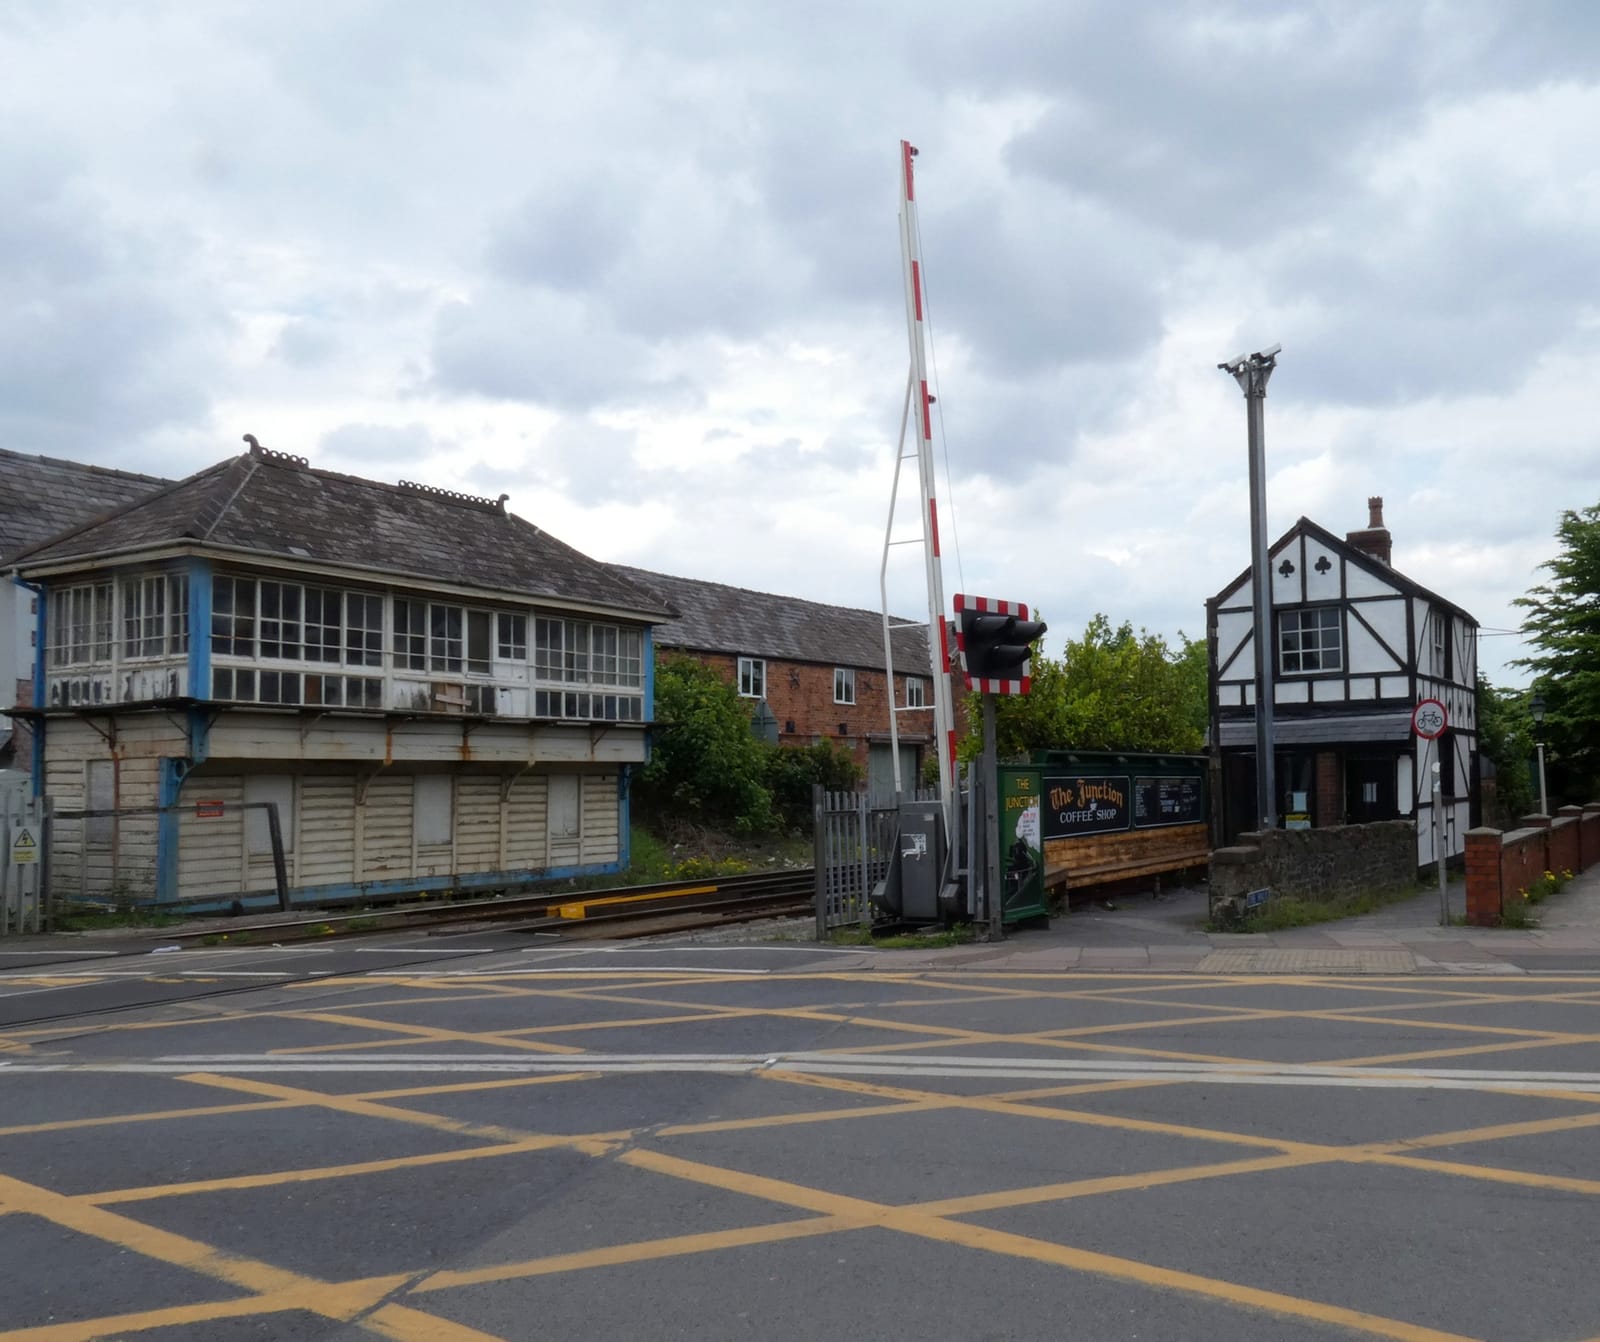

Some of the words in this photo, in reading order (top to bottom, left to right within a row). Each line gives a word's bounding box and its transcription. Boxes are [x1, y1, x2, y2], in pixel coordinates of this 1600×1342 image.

[1015, 778, 1030, 790] THE
[1049, 787, 1074, 811] The
[1075, 779, 1124, 809] Junction
[1059, 810, 1094, 824] COFFEE
[1096, 808, 1118, 821] SHOP
